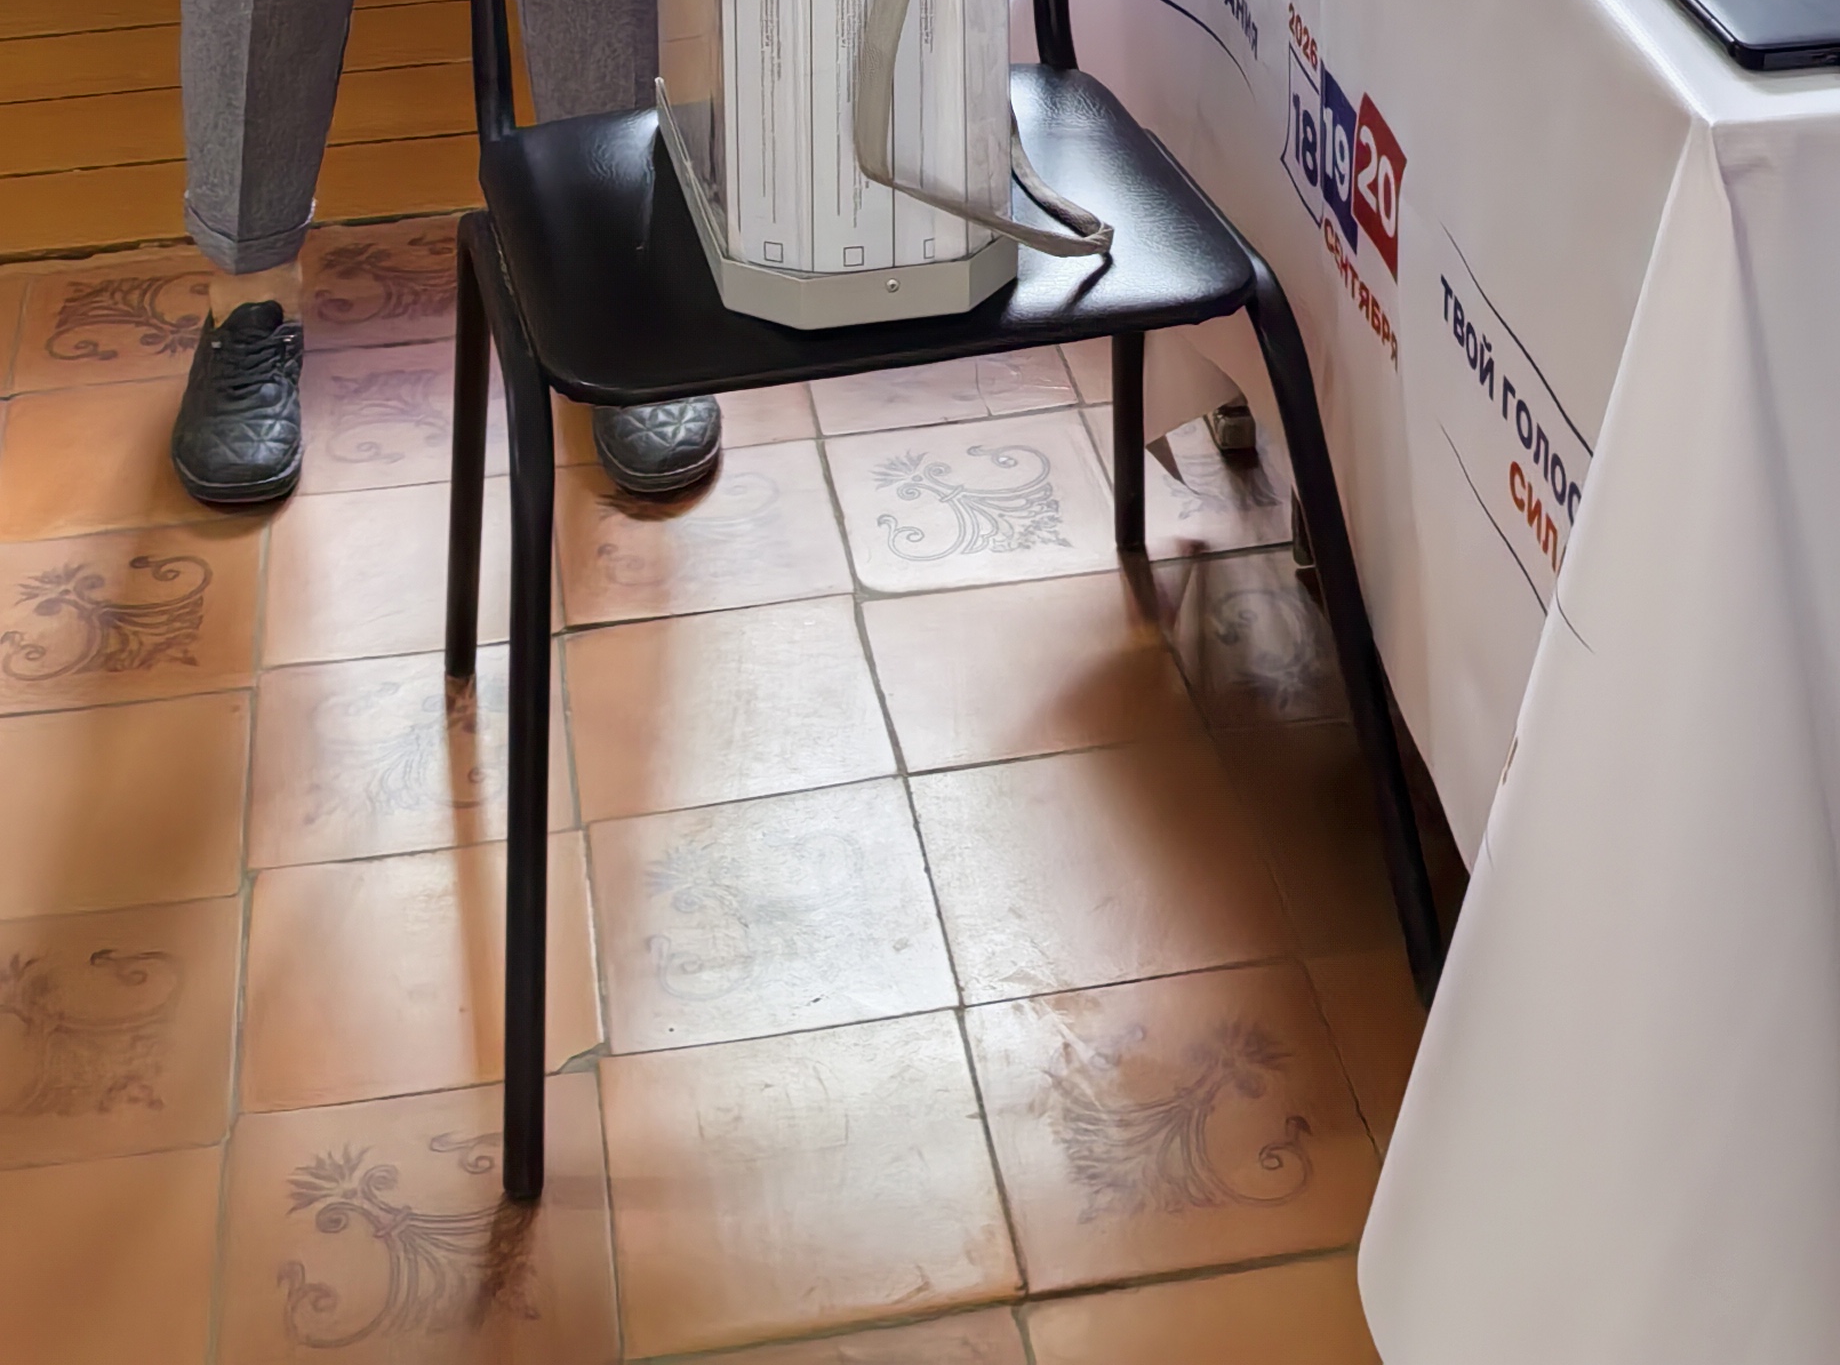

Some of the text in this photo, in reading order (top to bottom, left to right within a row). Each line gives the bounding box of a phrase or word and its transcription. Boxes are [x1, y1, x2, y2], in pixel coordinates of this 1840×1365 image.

[1289, 2, 1318, 72] 2026
[1293, 93, 1396, 239] 18 19 20
[1324, 218, 1397, 373] СЕНТЯБРЯ
[1440, 274, 1494, 401] ТВОЙ
